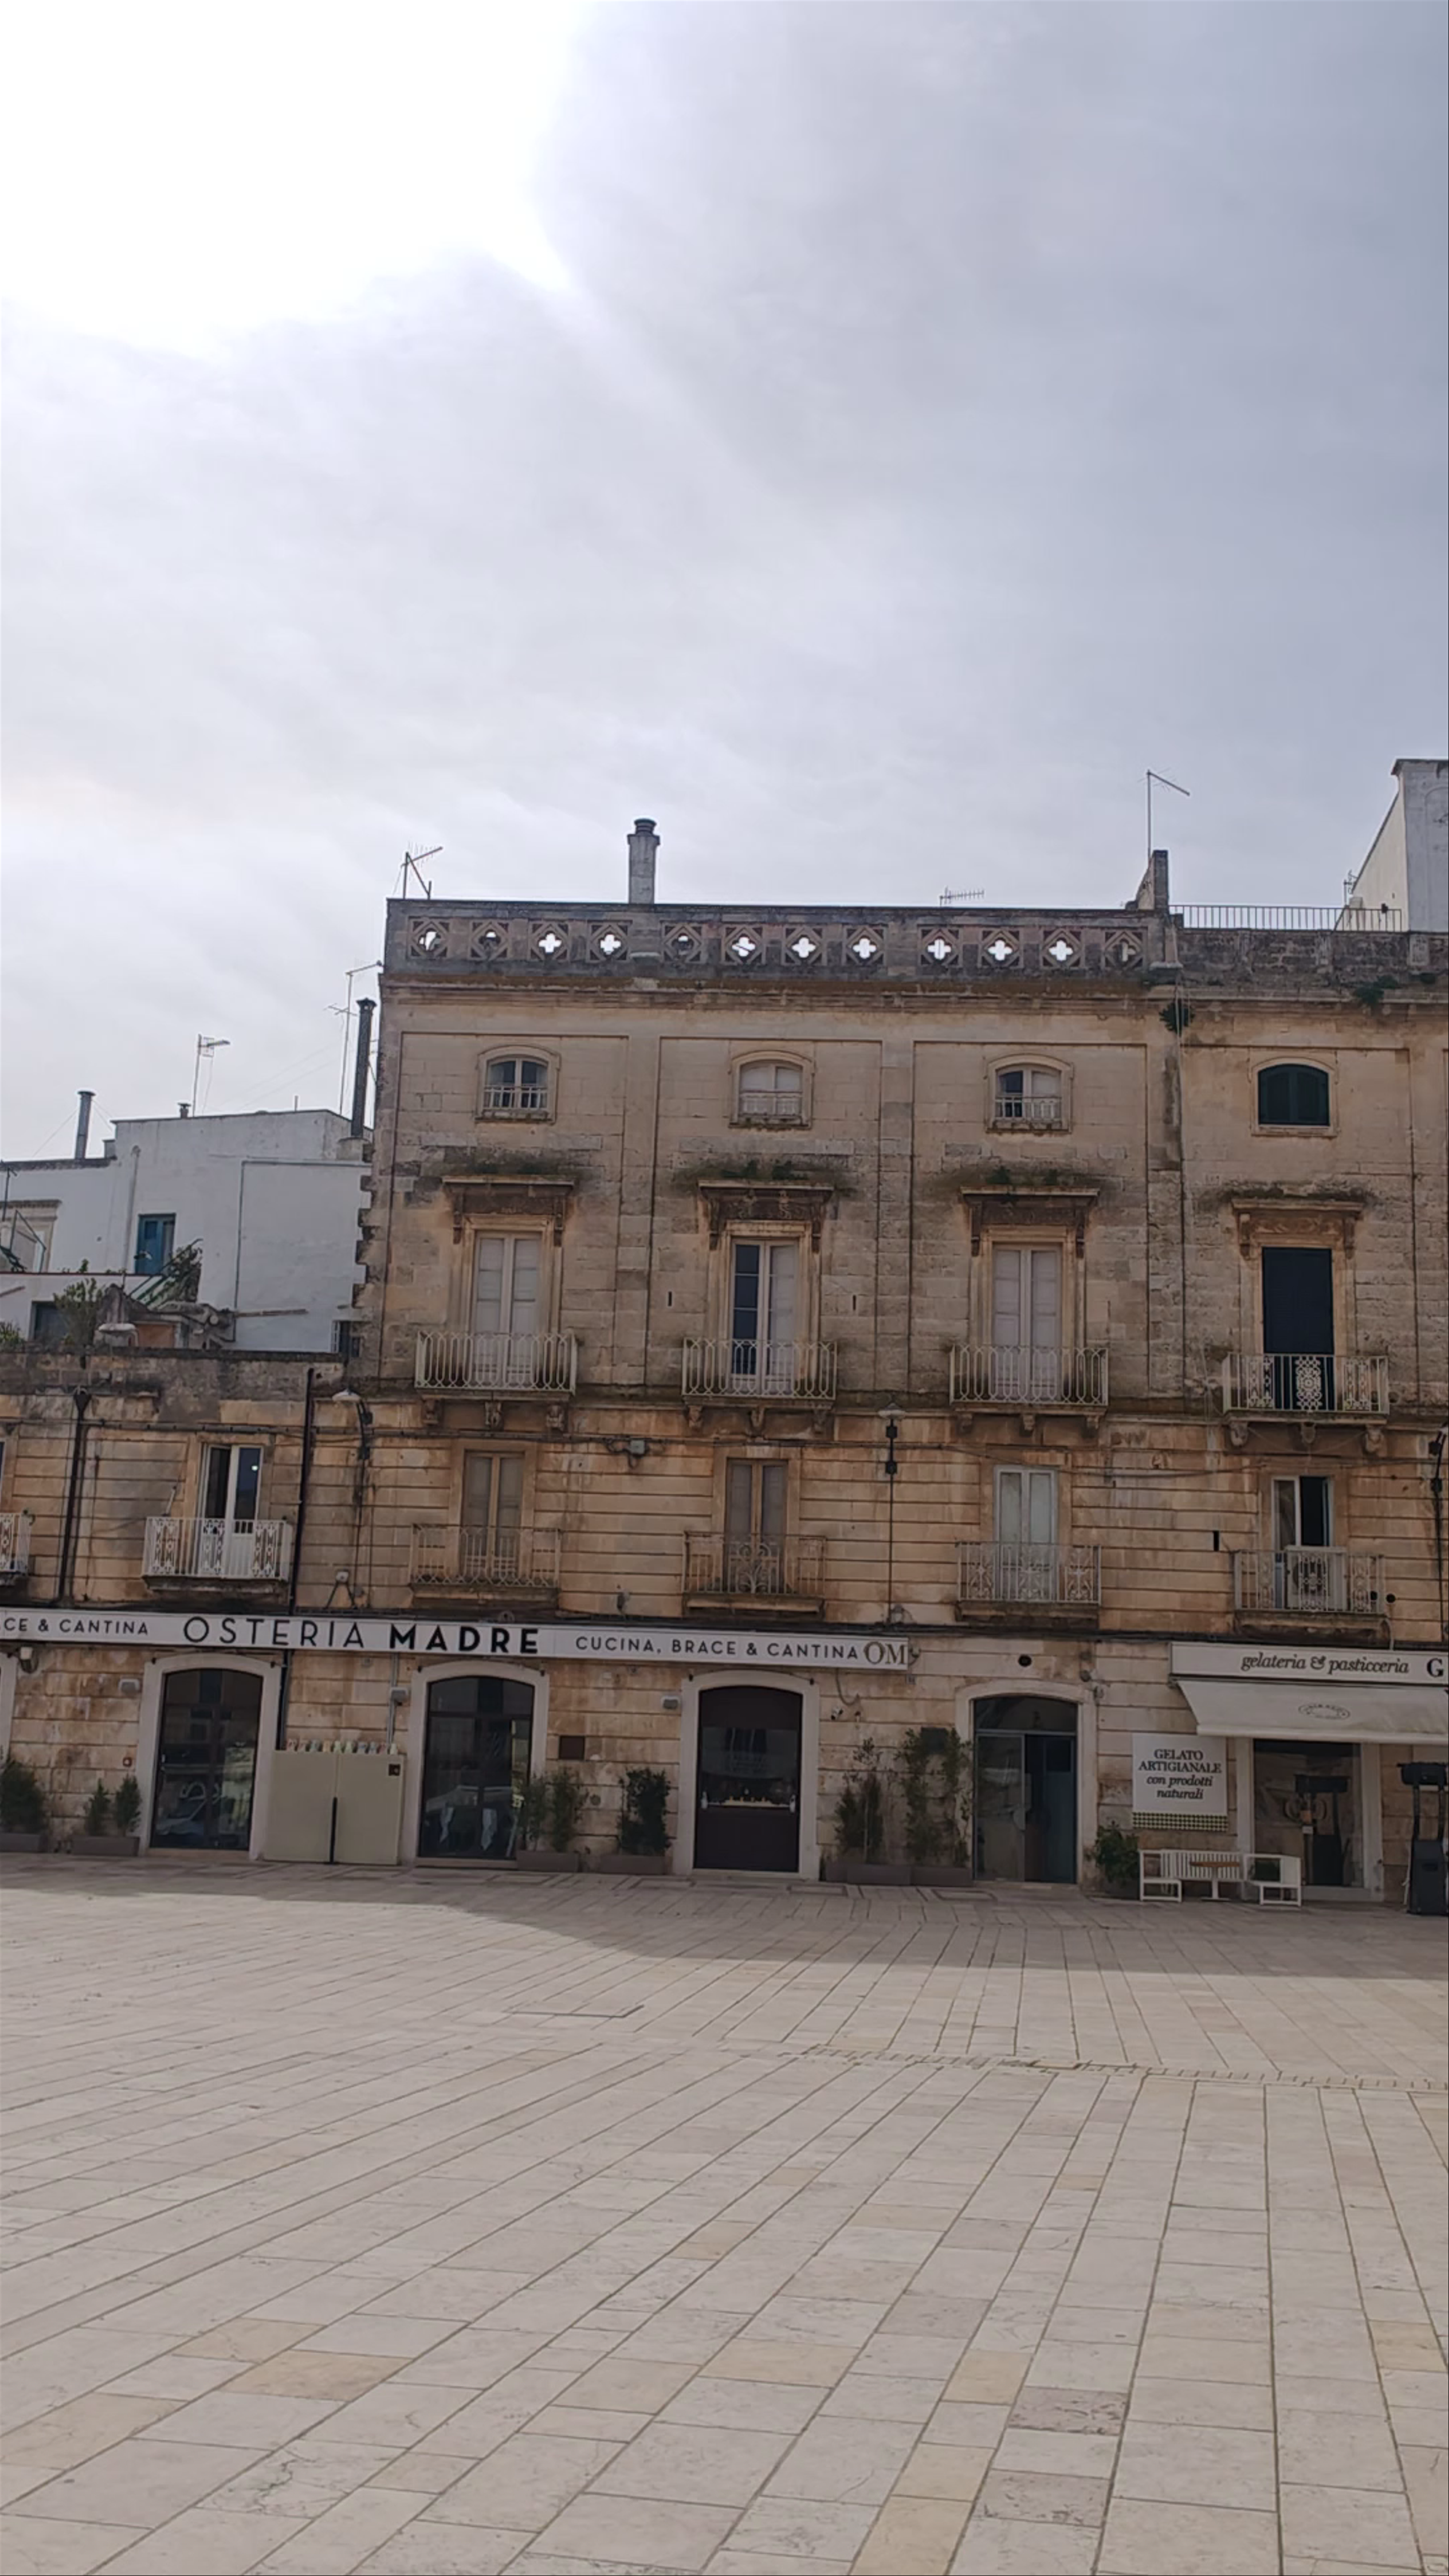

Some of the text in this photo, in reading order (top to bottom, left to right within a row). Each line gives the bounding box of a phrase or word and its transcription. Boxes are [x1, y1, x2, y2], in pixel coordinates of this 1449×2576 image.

[3, 1618, 148, 1635] CE & CANTINA
[183, 1616, 539, 1654] OSTERIA MADRE
[575, 1636, 858, 1659] CUCINA, BRACE & CANTINA
[863, 1641, 906, 1665] OM
[1240, 1651, 1409, 1675] gelateria & pasticceria
[1154, 1749, 1203, 1761] GELATO
[1138, 1761, 1222, 1773] ARTIGIANALE
[1146, 1774, 1214, 1788] con prodotti
[1157, 1788, 1203, 1799] naturali
